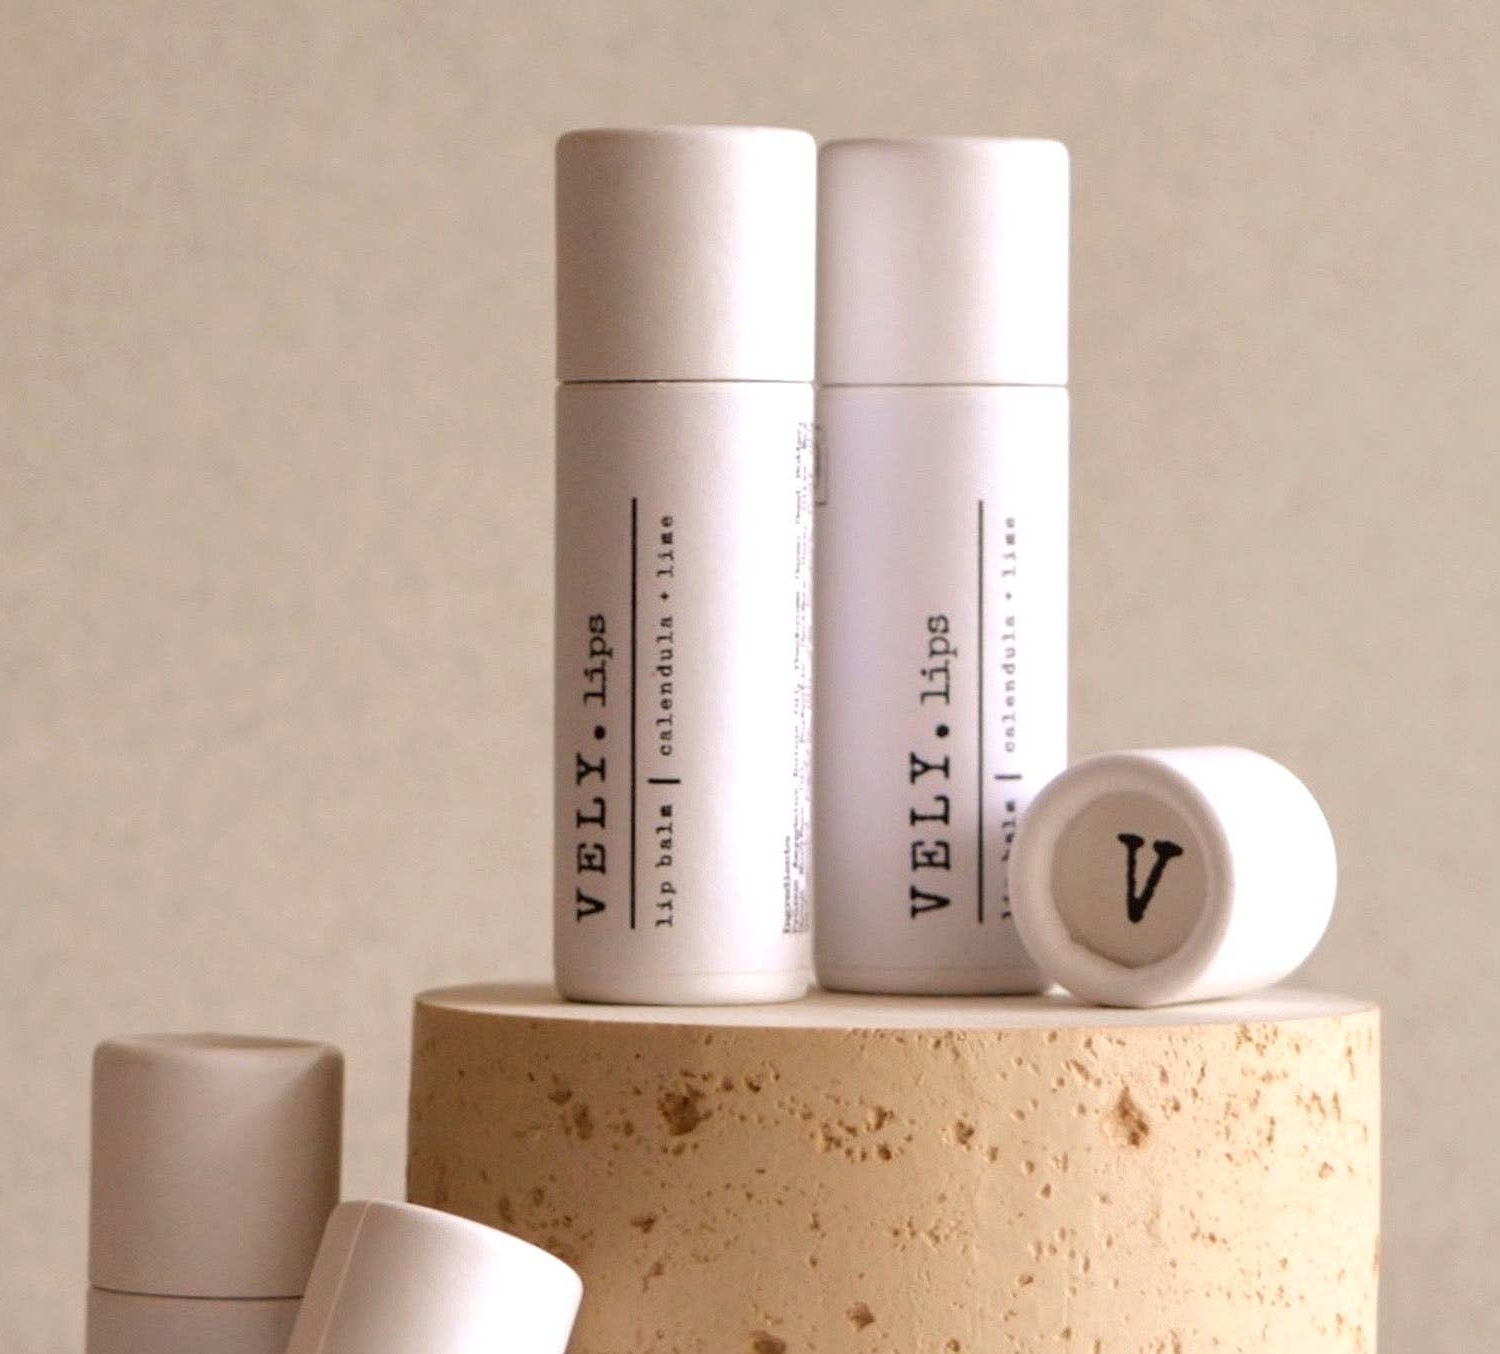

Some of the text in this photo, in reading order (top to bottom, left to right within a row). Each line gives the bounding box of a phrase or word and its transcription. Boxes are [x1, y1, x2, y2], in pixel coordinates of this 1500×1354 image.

[656, 514, 675, 578] lime
[1001, 515, 1017, 577] lime
[655, 616, 675, 757] calendula
[1000, 614, 1017, 753] calendula
[575, 612, 613, 921] VELY. lips
[909, 613, 957, 920] VELY. lips
[655, 803, 674, 868] balm
[1117, 833, 1184, 923] V
[655, 880, 675, 928] lip
